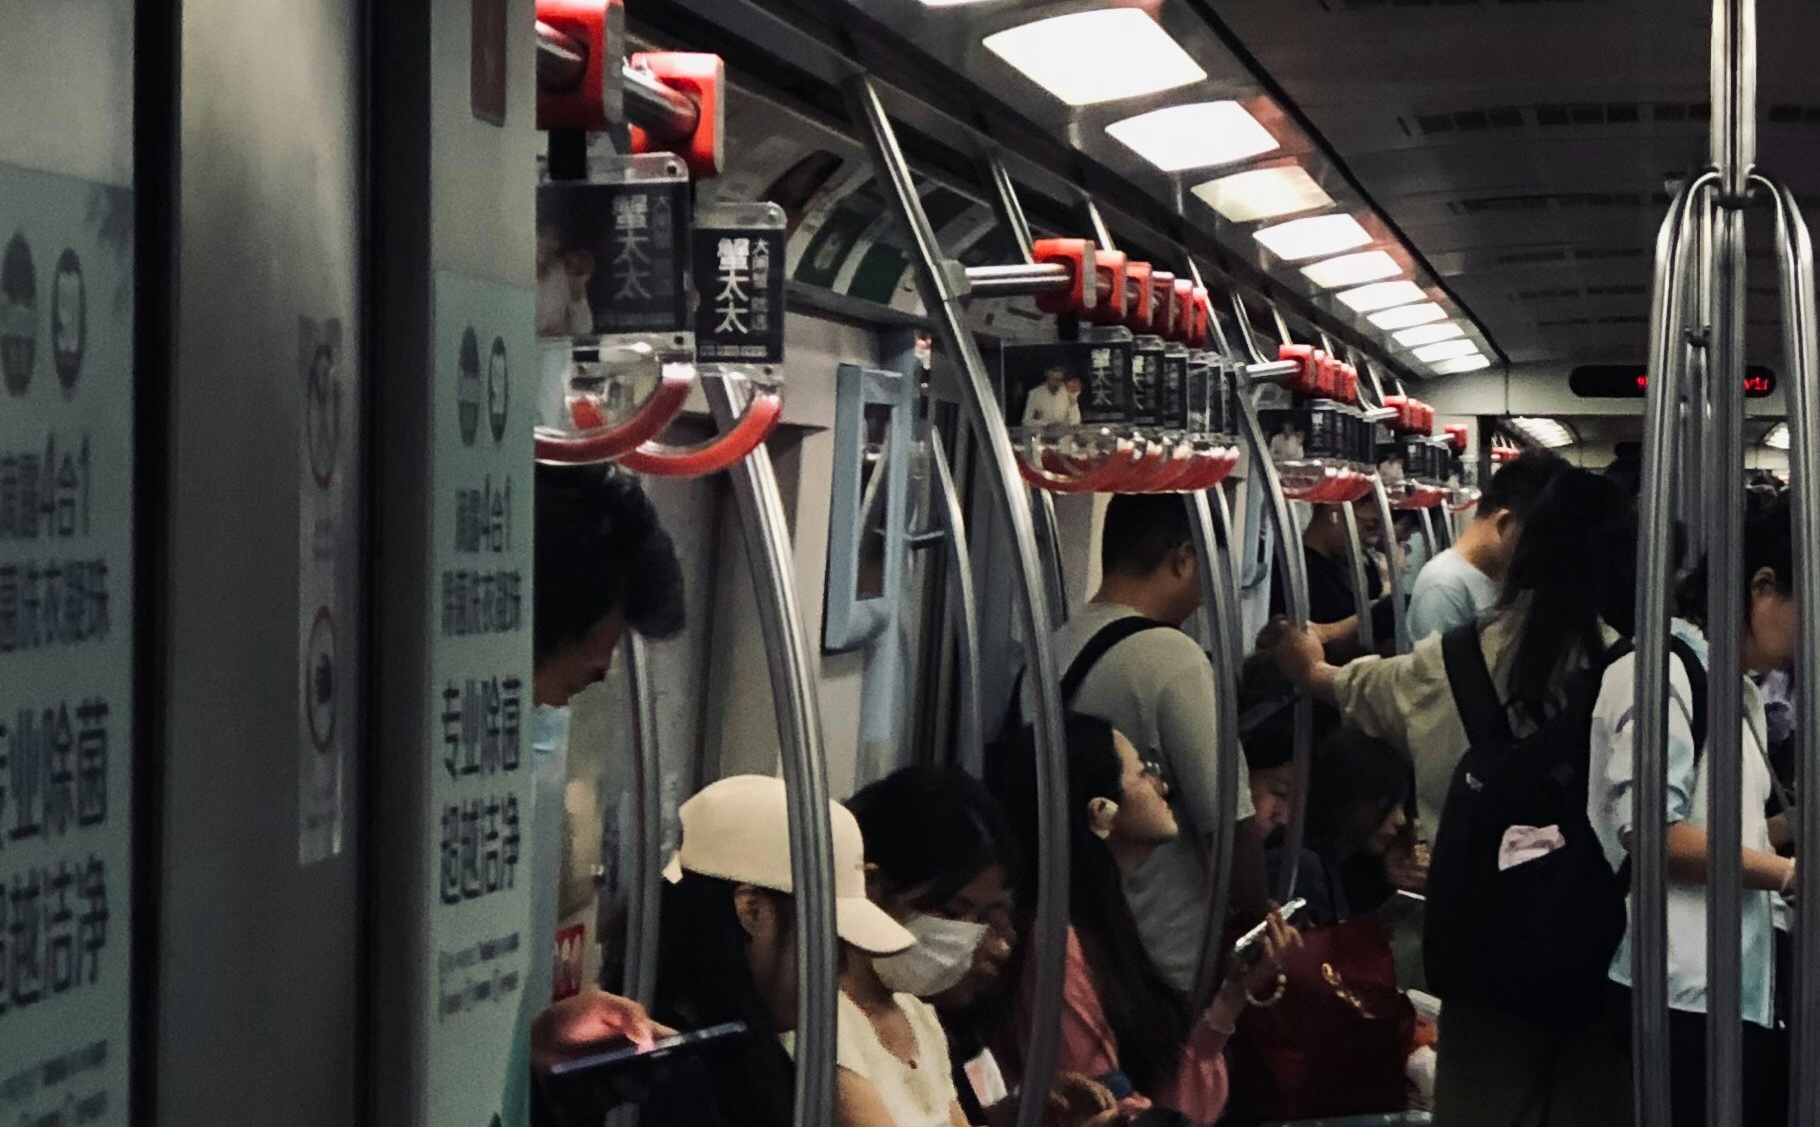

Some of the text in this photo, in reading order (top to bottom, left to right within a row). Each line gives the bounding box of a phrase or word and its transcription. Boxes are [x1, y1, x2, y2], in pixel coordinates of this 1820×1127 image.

[0, 698, 109, 851] 业除菌
[442, 676, 521, 779] 专业除菌
[440, 793, 521, 905] 超越洁净
[0, 854, 109, 1015] 越洁净
